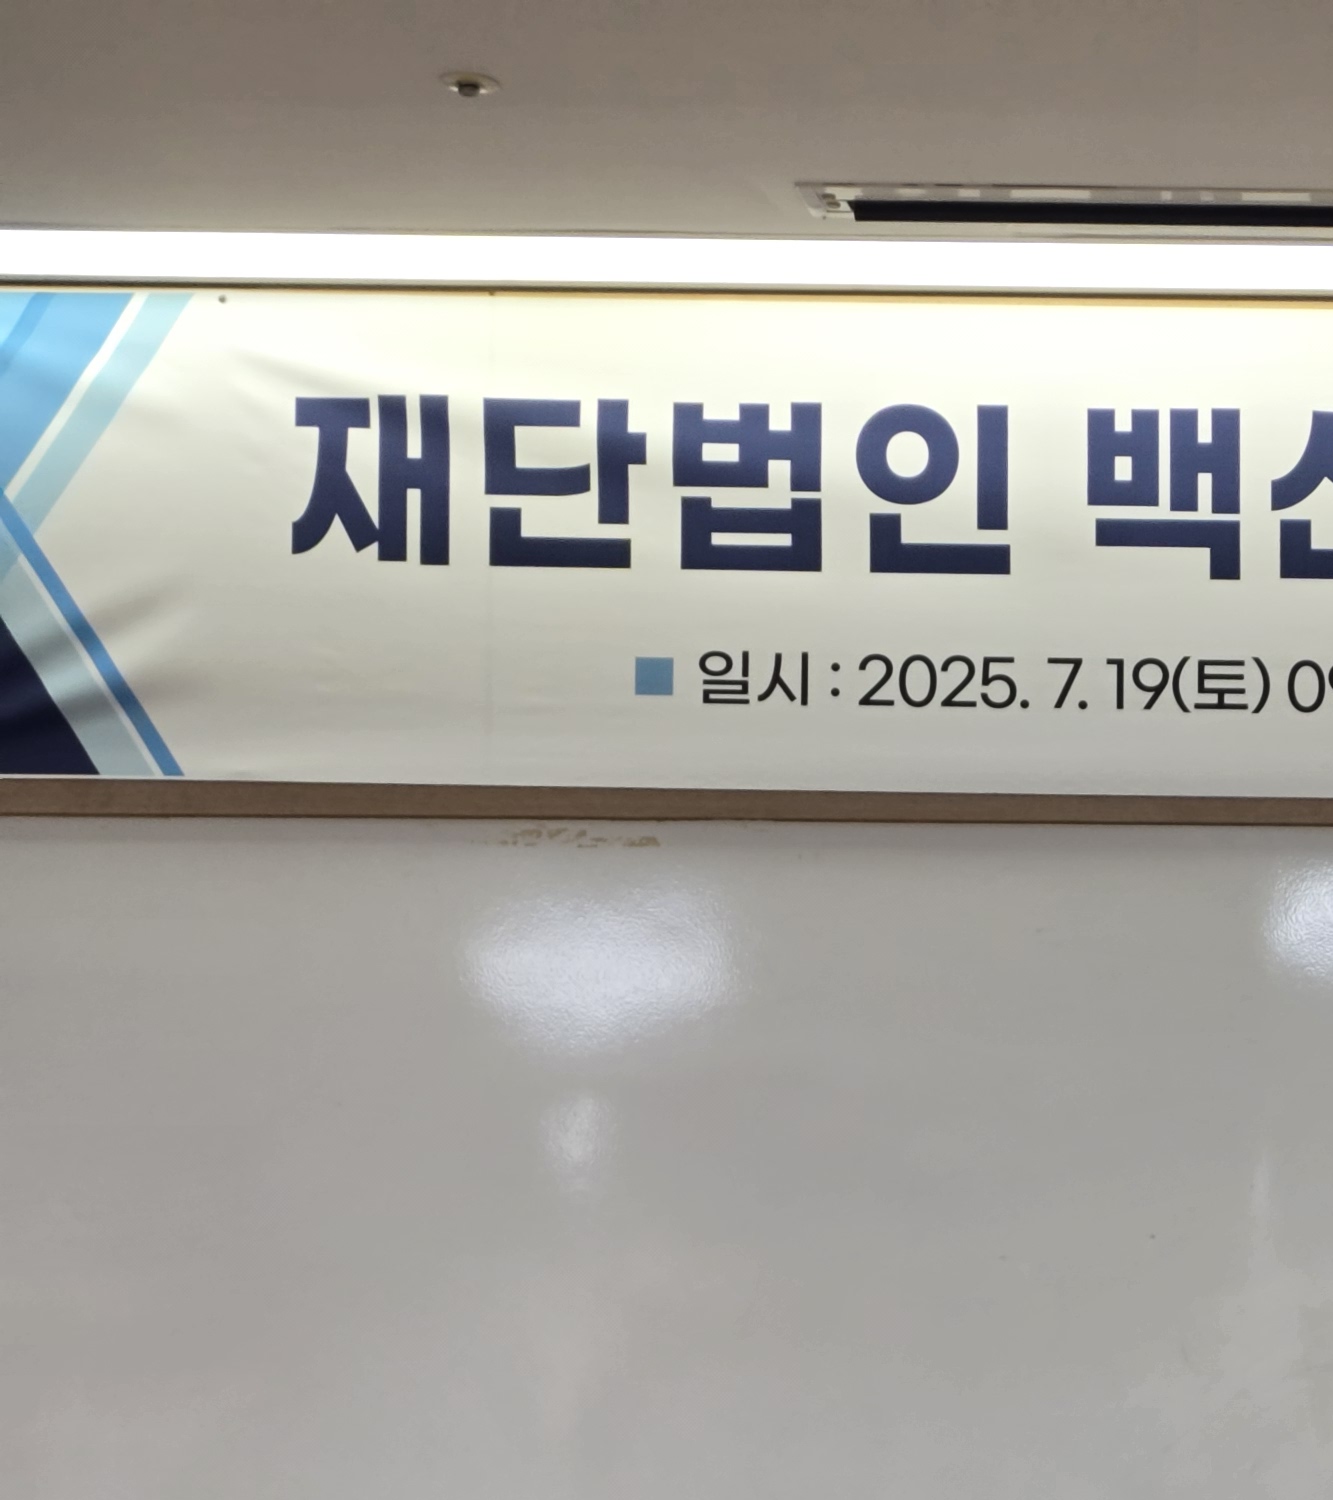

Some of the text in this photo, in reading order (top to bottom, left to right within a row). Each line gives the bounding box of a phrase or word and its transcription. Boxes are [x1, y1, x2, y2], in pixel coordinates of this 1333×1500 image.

[290, 394, 1012, 576] 재단법인
[697, 649, 810, 708] 일시
[857, 652, 1031, 711] 2025.
[1046, 656, 1089, 711] 7.
[1105, 655, 1272, 715] 19(토)
